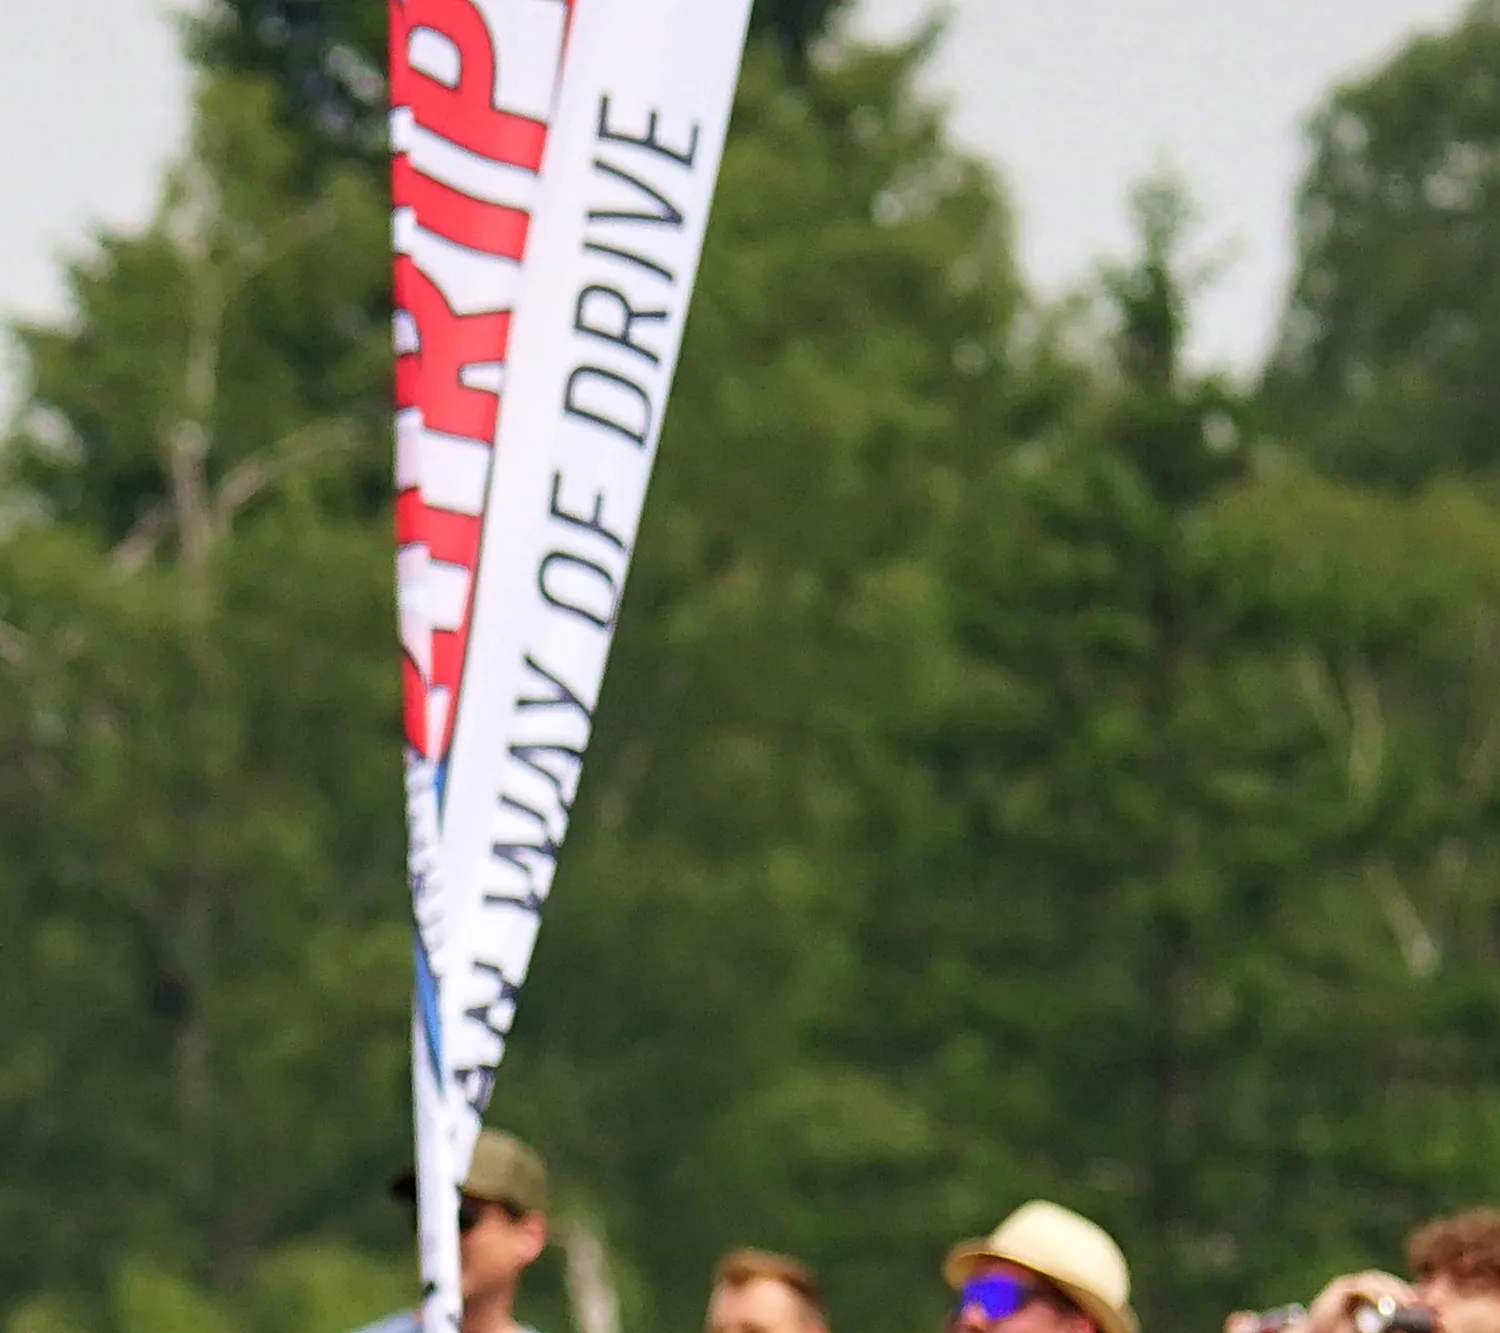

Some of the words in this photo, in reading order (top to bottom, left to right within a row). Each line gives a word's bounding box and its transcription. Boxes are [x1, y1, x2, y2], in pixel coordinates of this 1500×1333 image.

[561, 94, 700, 449] DRIVE
[535, 469, 630, 632] OF
[482, 652, 595, 910] WAY
